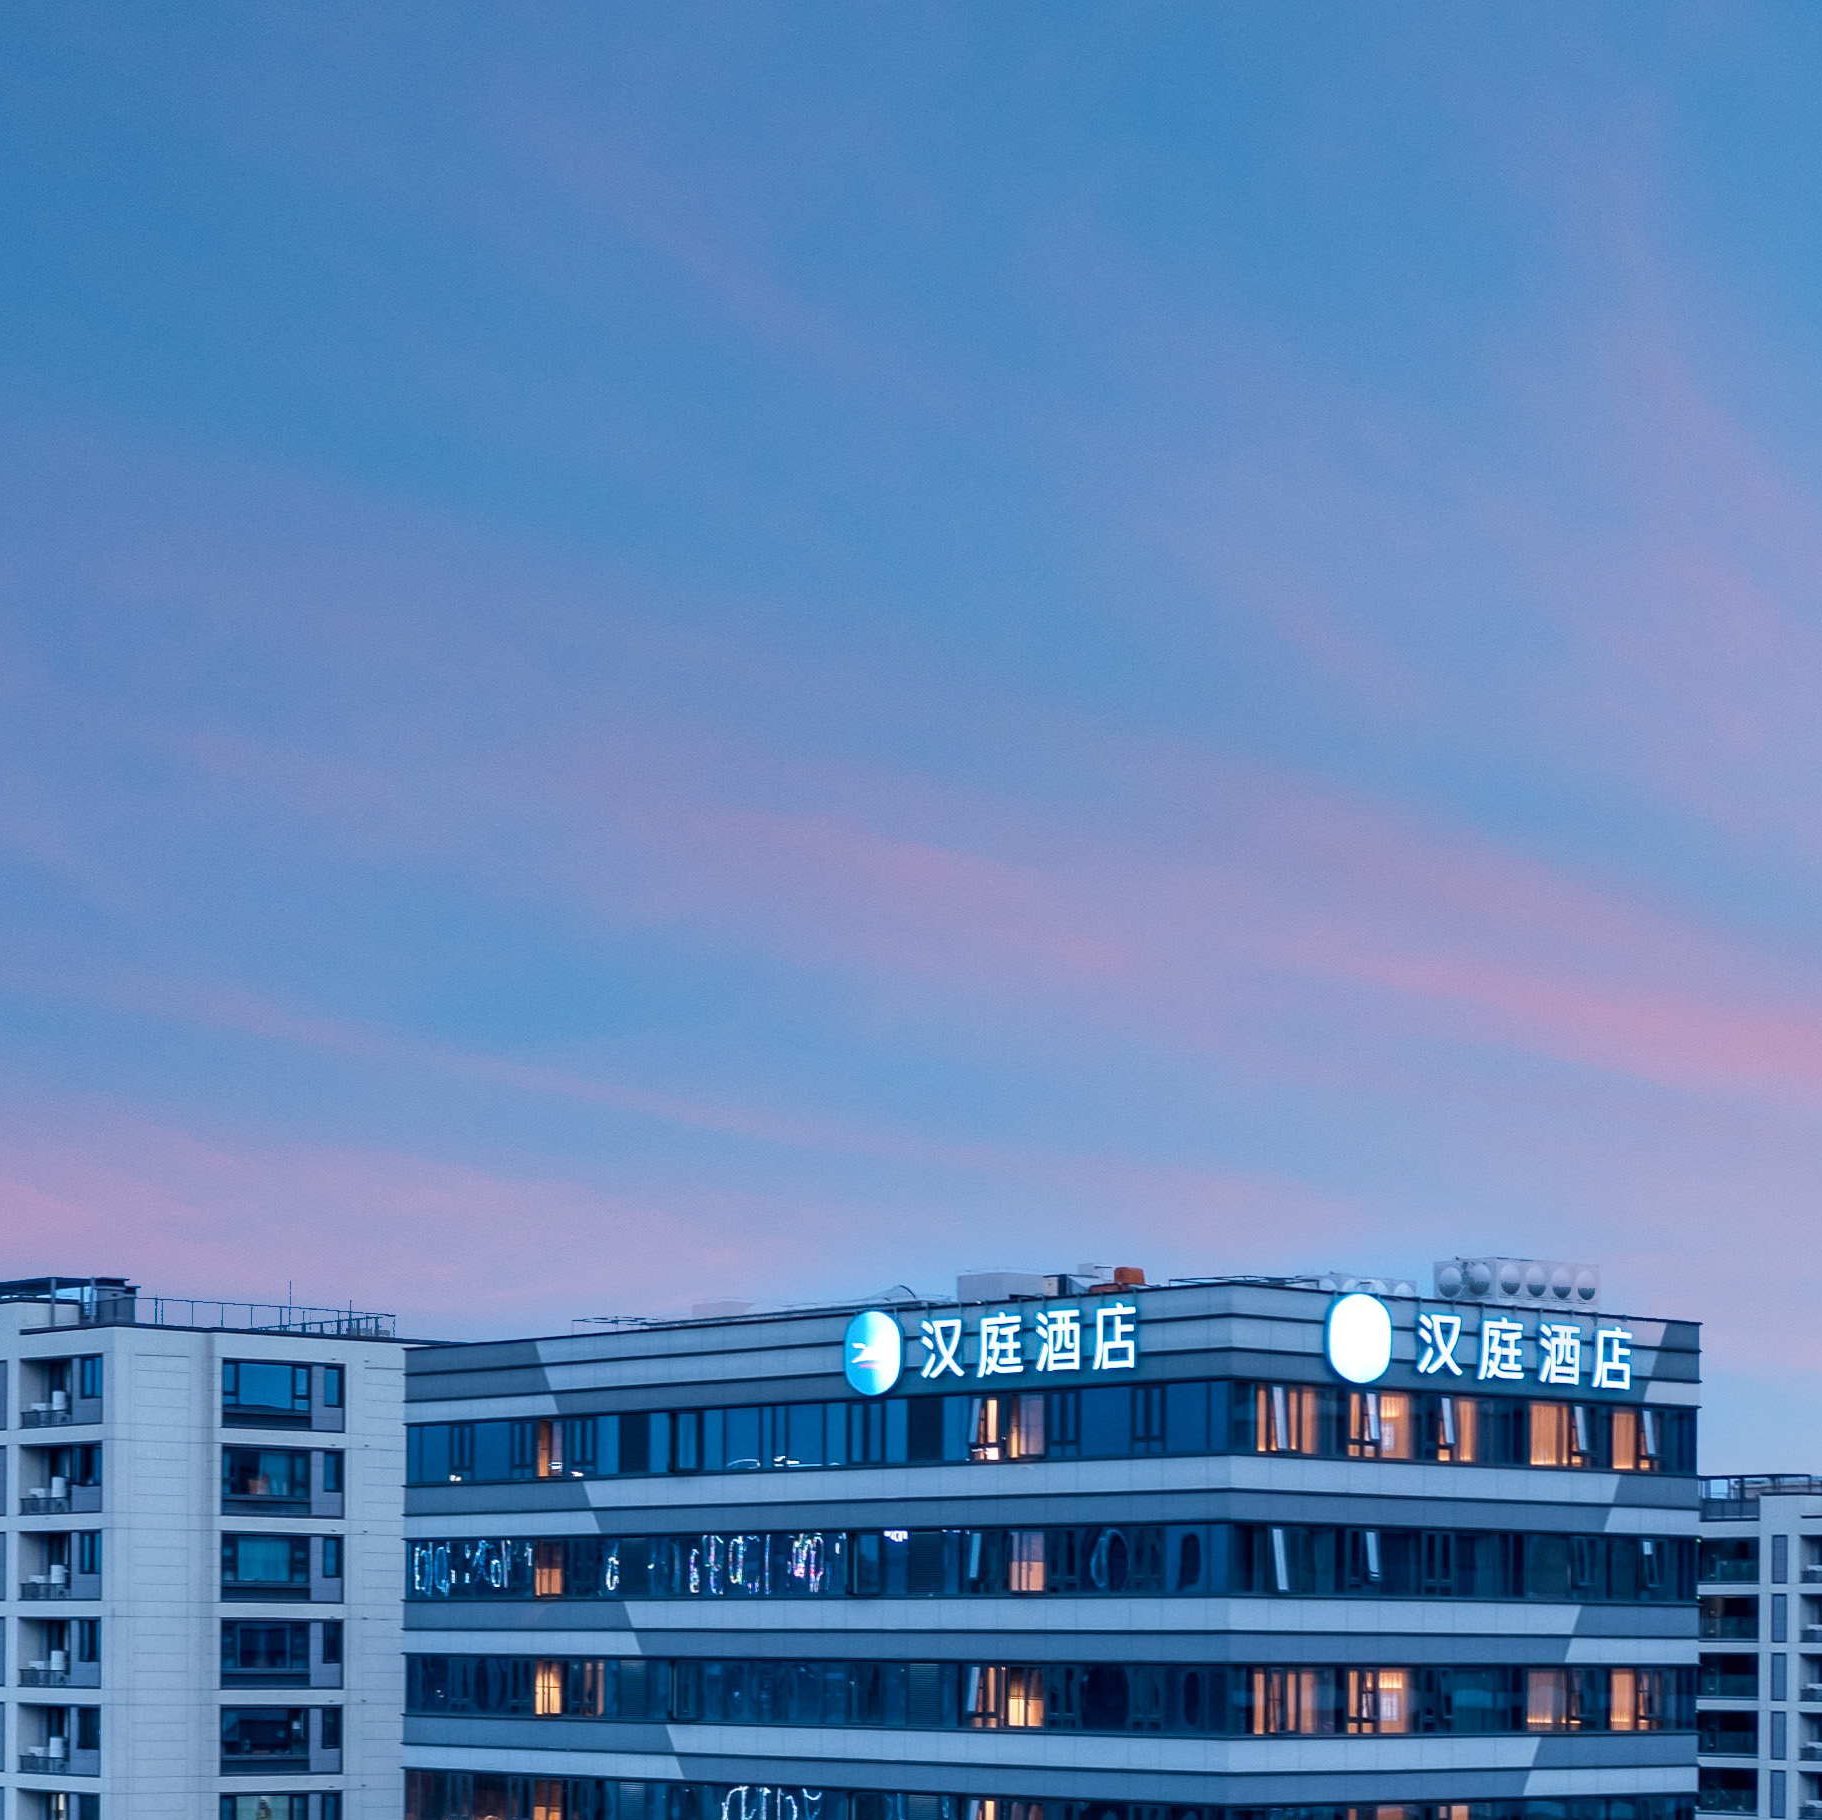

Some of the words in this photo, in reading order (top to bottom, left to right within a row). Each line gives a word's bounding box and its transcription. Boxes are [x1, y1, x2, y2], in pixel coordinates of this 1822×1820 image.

[920, 1302, 1136, 1379] 汉庭酒店
[1416, 1314, 1633, 1390] 汉庭酒店
